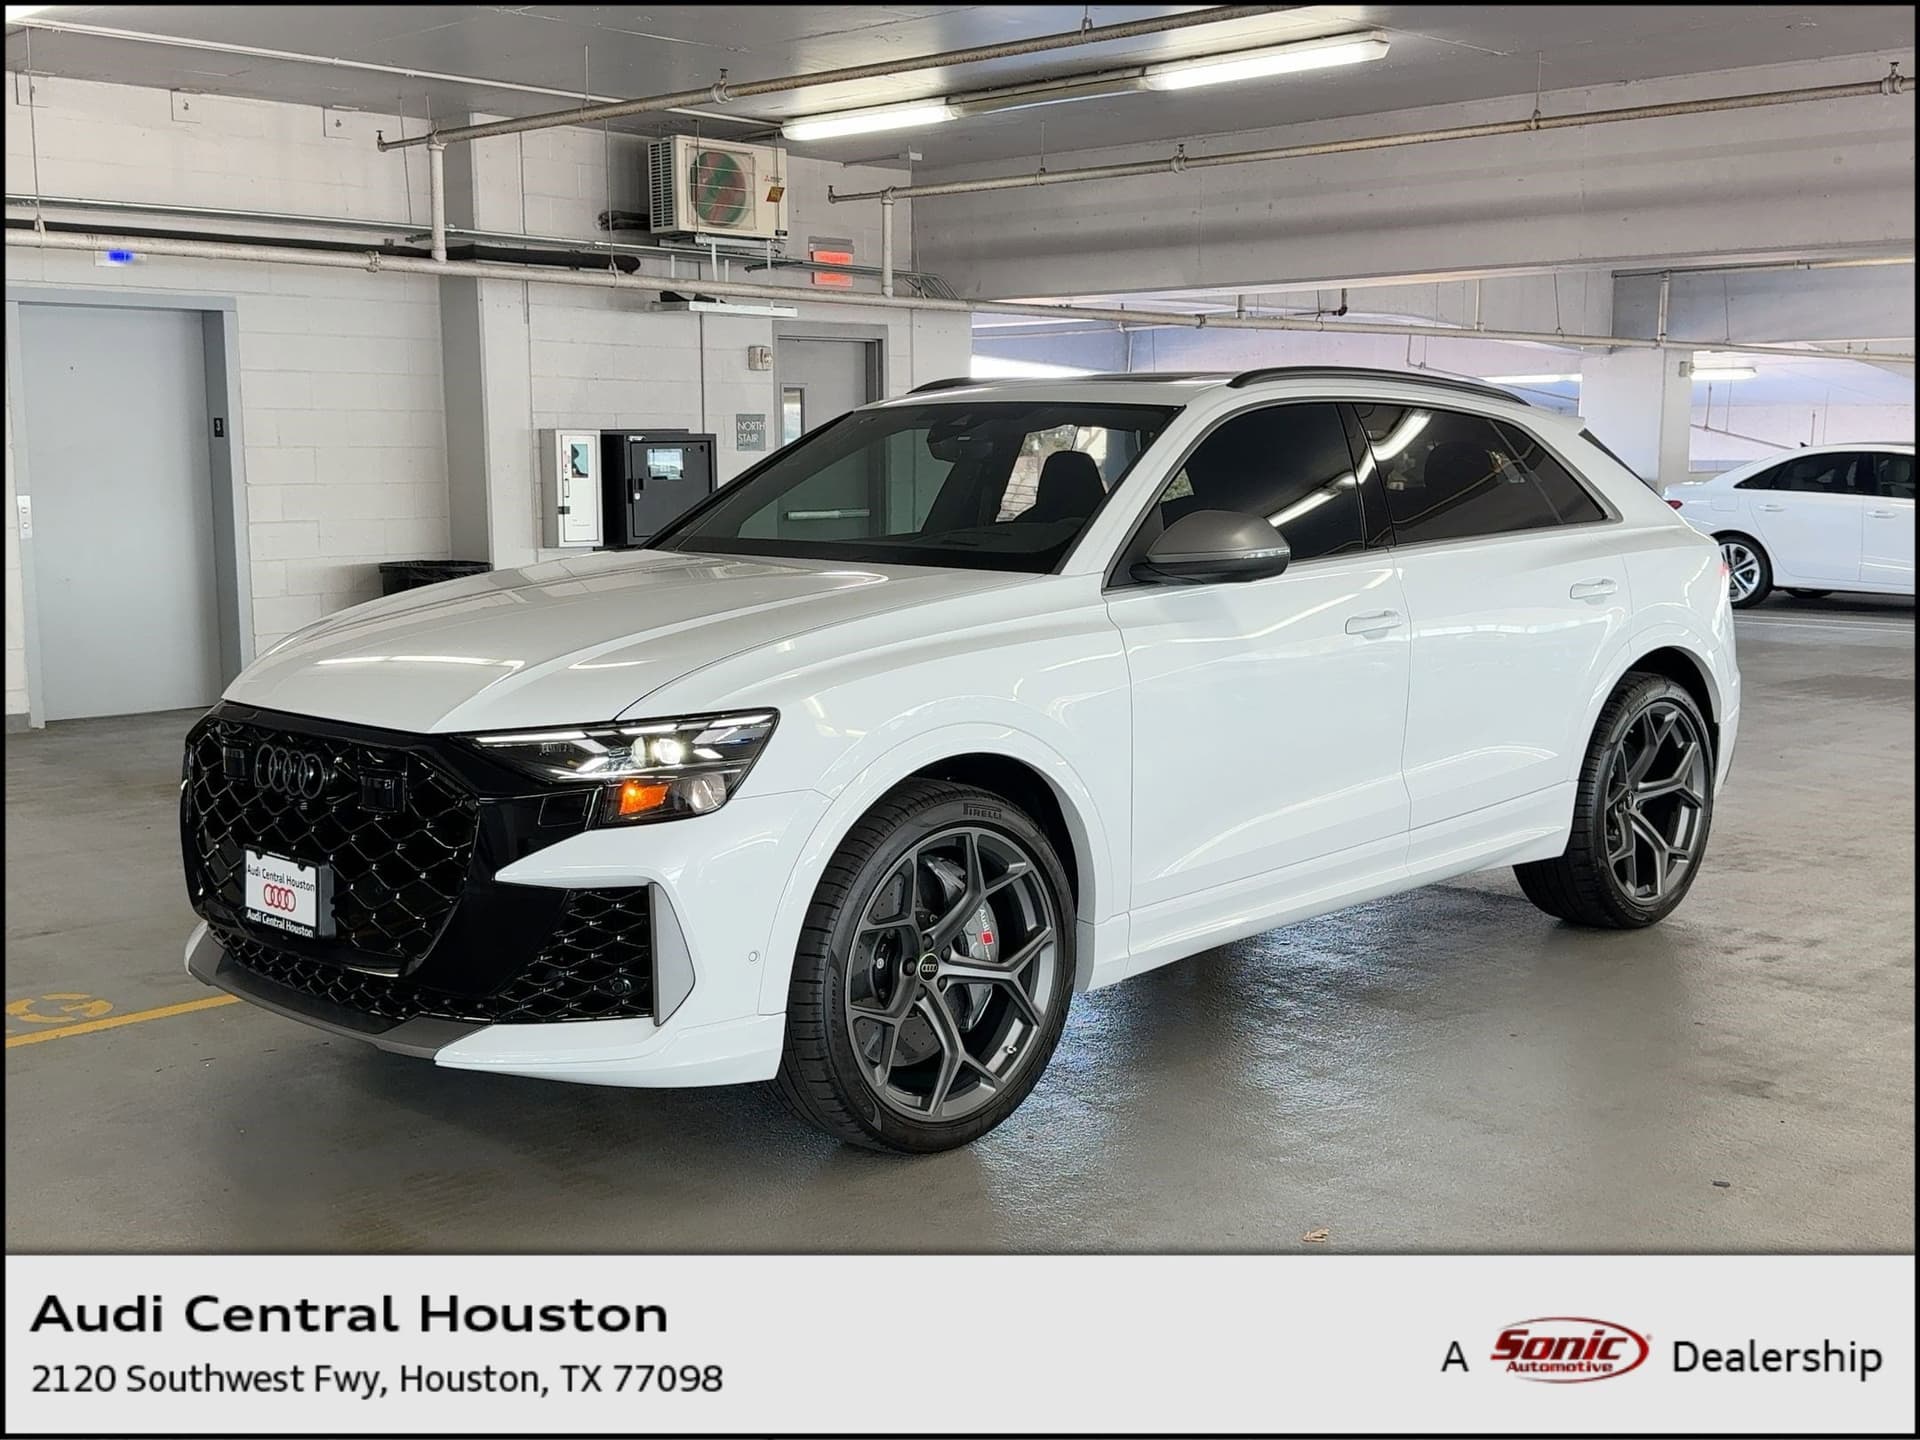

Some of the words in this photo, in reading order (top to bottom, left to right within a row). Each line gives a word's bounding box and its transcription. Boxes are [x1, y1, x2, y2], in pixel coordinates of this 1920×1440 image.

[737, 421, 767, 431] NORTH
[962, 802, 1001, 820] PIRELLI
[246, 863, 261, 877] Audi
[262, 868, 284, 884] Central
[286, 875, 315, 892] Houston
[246, 908, 261, 923] Audi
[262, 913, 285, 930] Central
[286, 920, 314, 938] Houston
[979, 908, 991, 931] Audi
